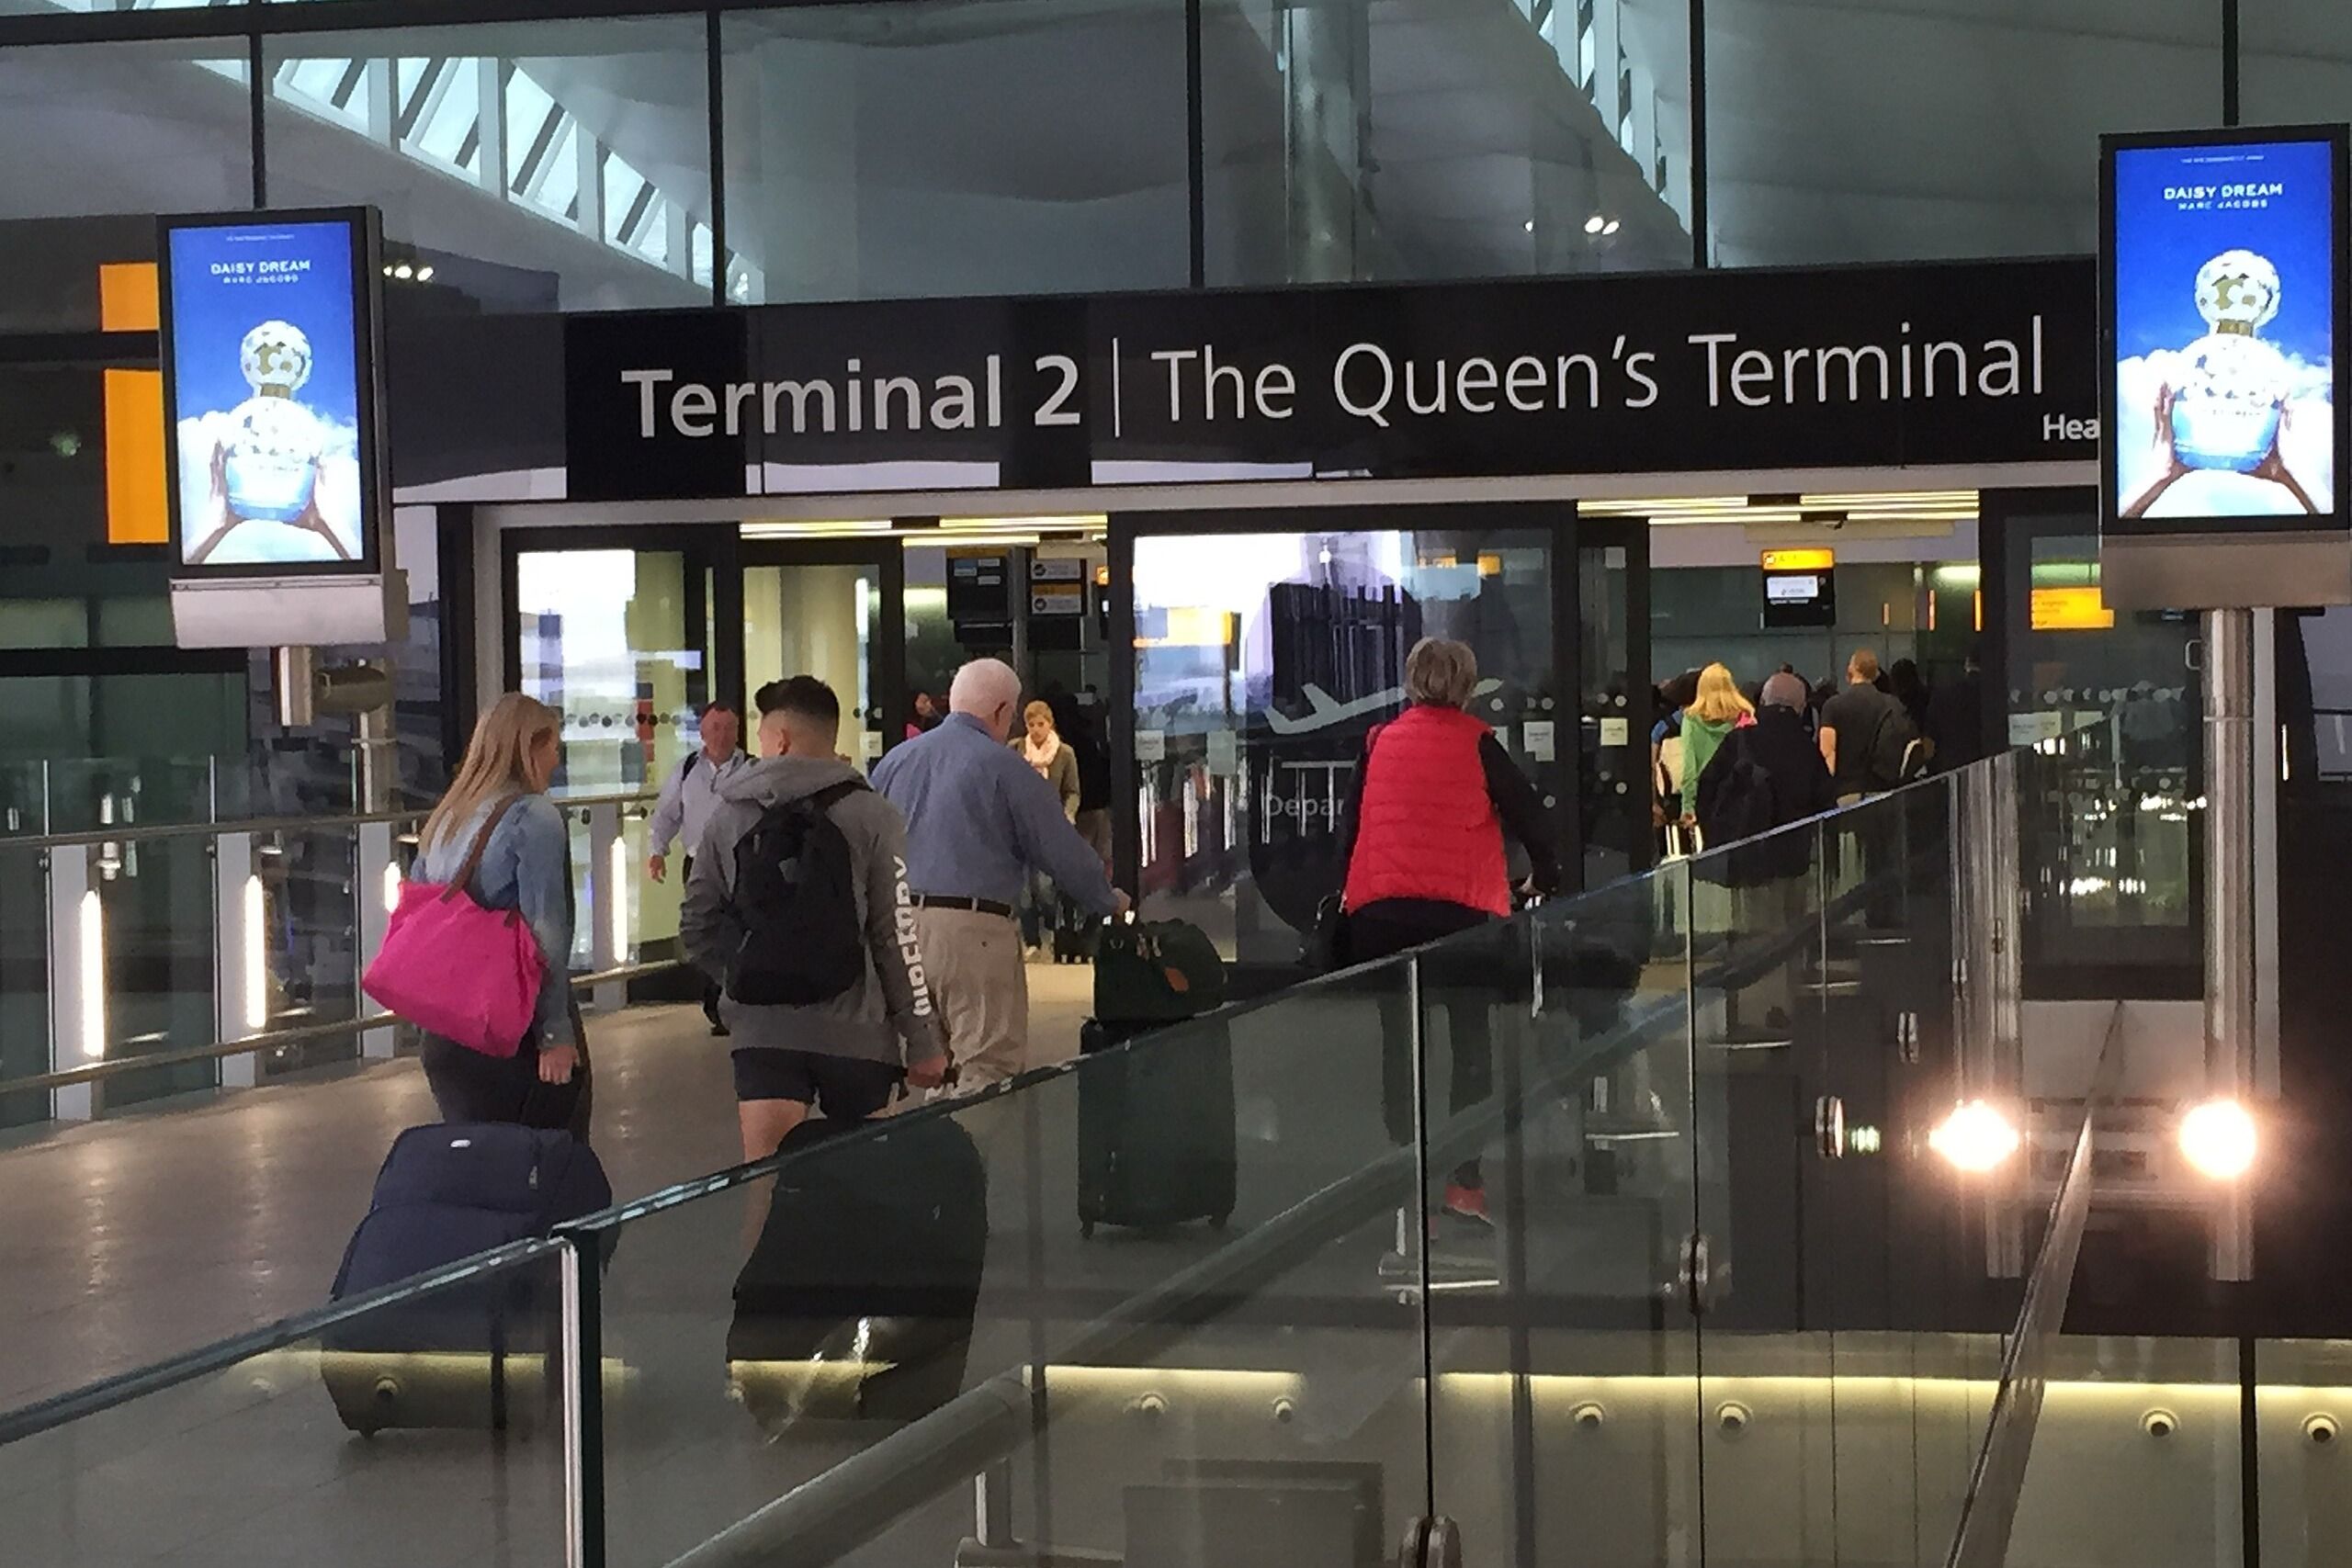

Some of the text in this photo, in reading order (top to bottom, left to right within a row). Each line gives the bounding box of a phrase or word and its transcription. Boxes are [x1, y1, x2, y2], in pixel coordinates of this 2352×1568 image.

[2164, 183, 2283, 199] DAISY DREAM
[210, 260, 311, 275] DAISY DREAM
[621, 315, 2042, 437] Terminal 2 The Queen's Terminal
